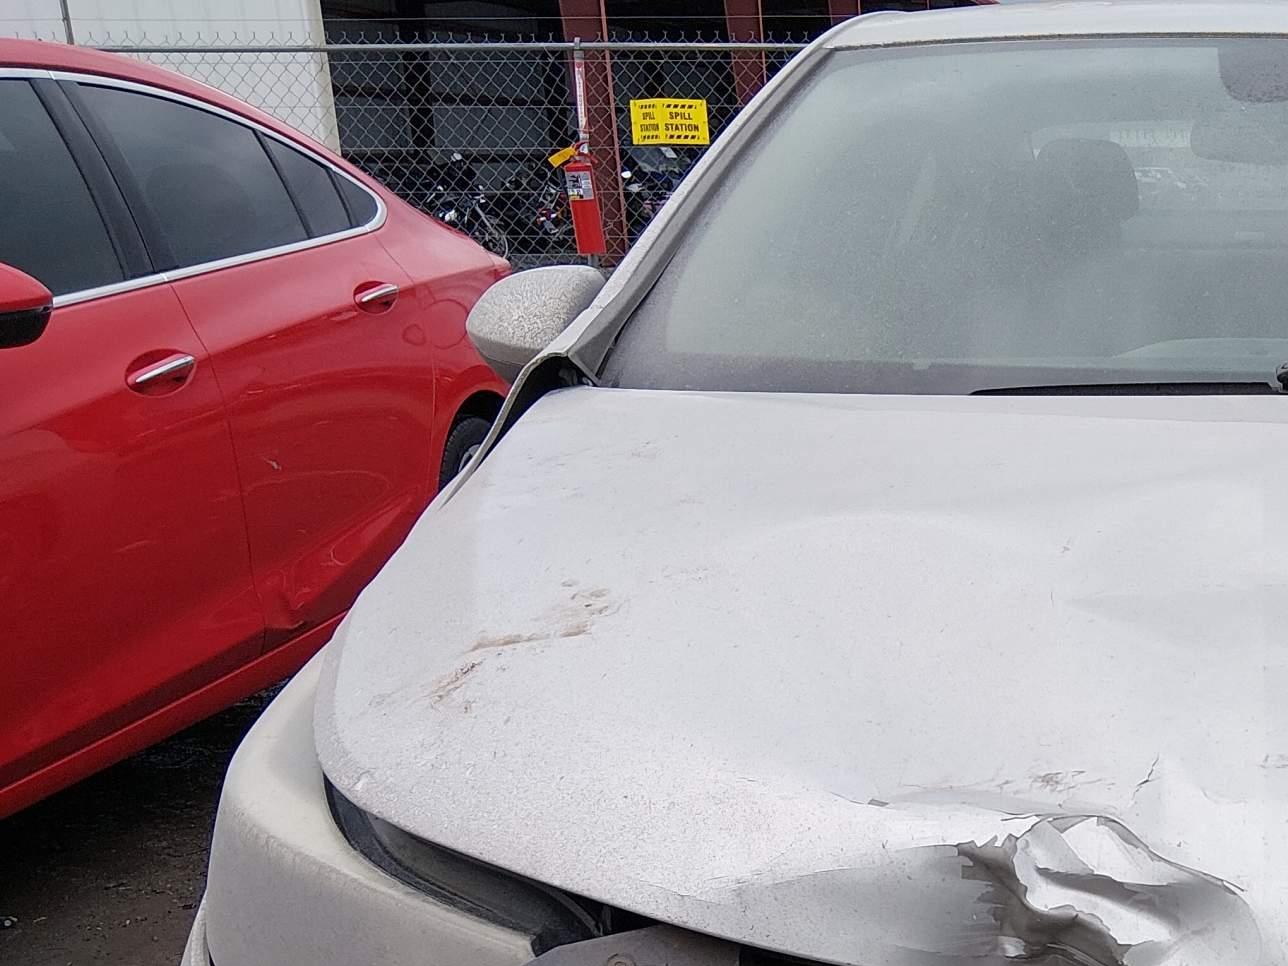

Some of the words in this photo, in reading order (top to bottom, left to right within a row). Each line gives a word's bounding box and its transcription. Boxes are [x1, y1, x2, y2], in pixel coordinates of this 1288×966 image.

[642, 111, 655, 120] SPILL
[669, 111, 693, 120] SPILL
[640, 123, 659, 132] STATION
[664, 122, 699, 132] STATION
